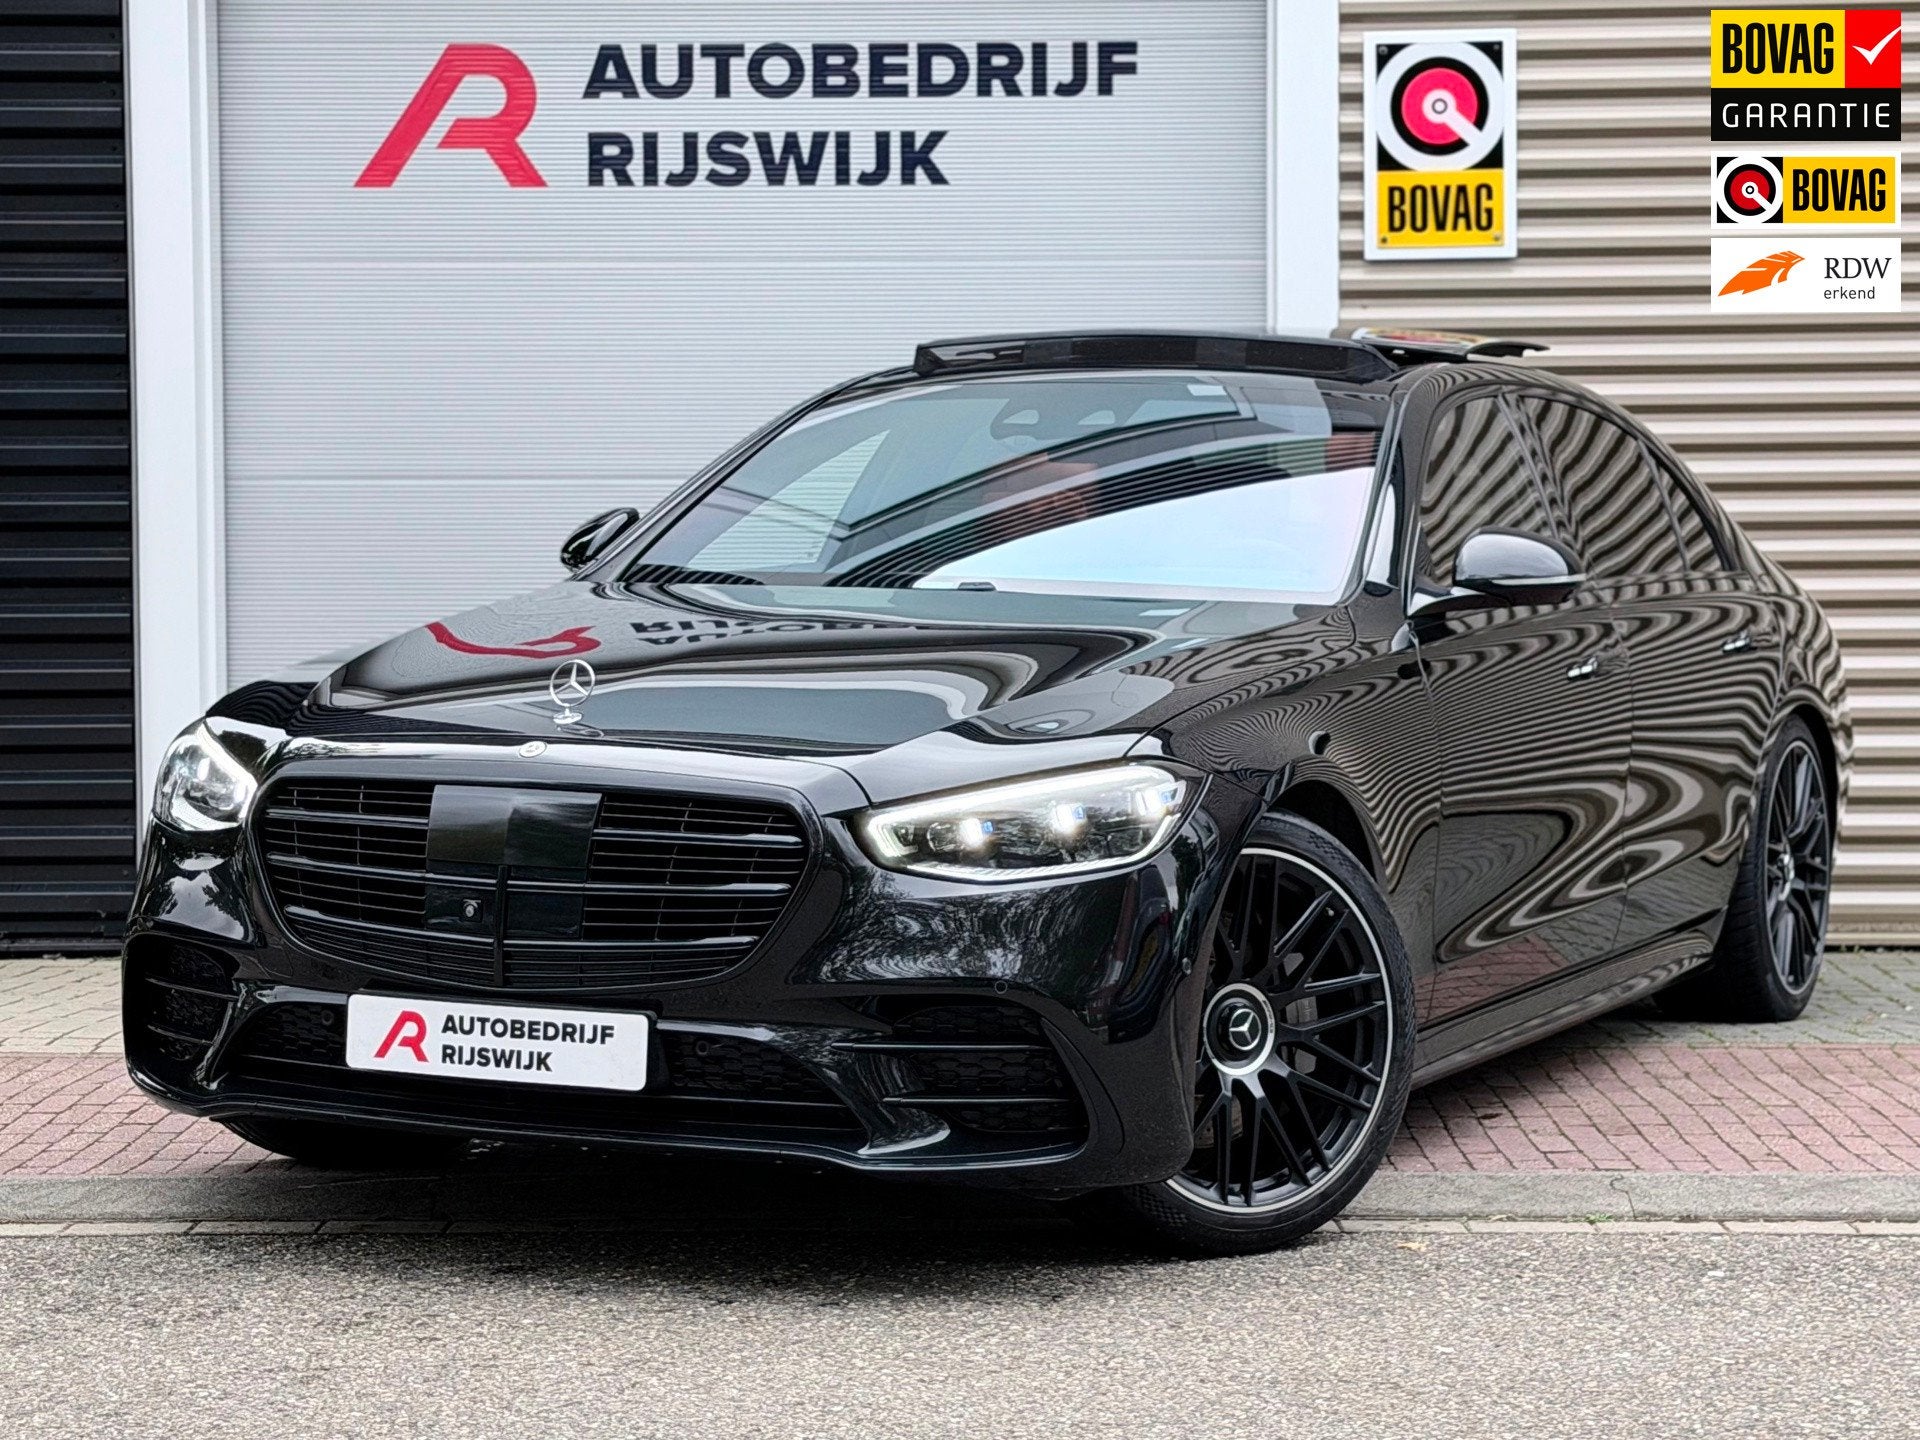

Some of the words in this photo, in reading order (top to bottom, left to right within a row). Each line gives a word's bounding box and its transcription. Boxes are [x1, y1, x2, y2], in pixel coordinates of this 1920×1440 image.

[582, 41, 1138, 99] AUTOBEDRIJF
[587, 130, 949, 187] RIJSWIJK
[1387, 183, 1494, 233] BOVAG
[441, 1014, 615, 1045] AUTOBEDRIJF
[441, 1044, 553, 1072] RIJSWIJK
